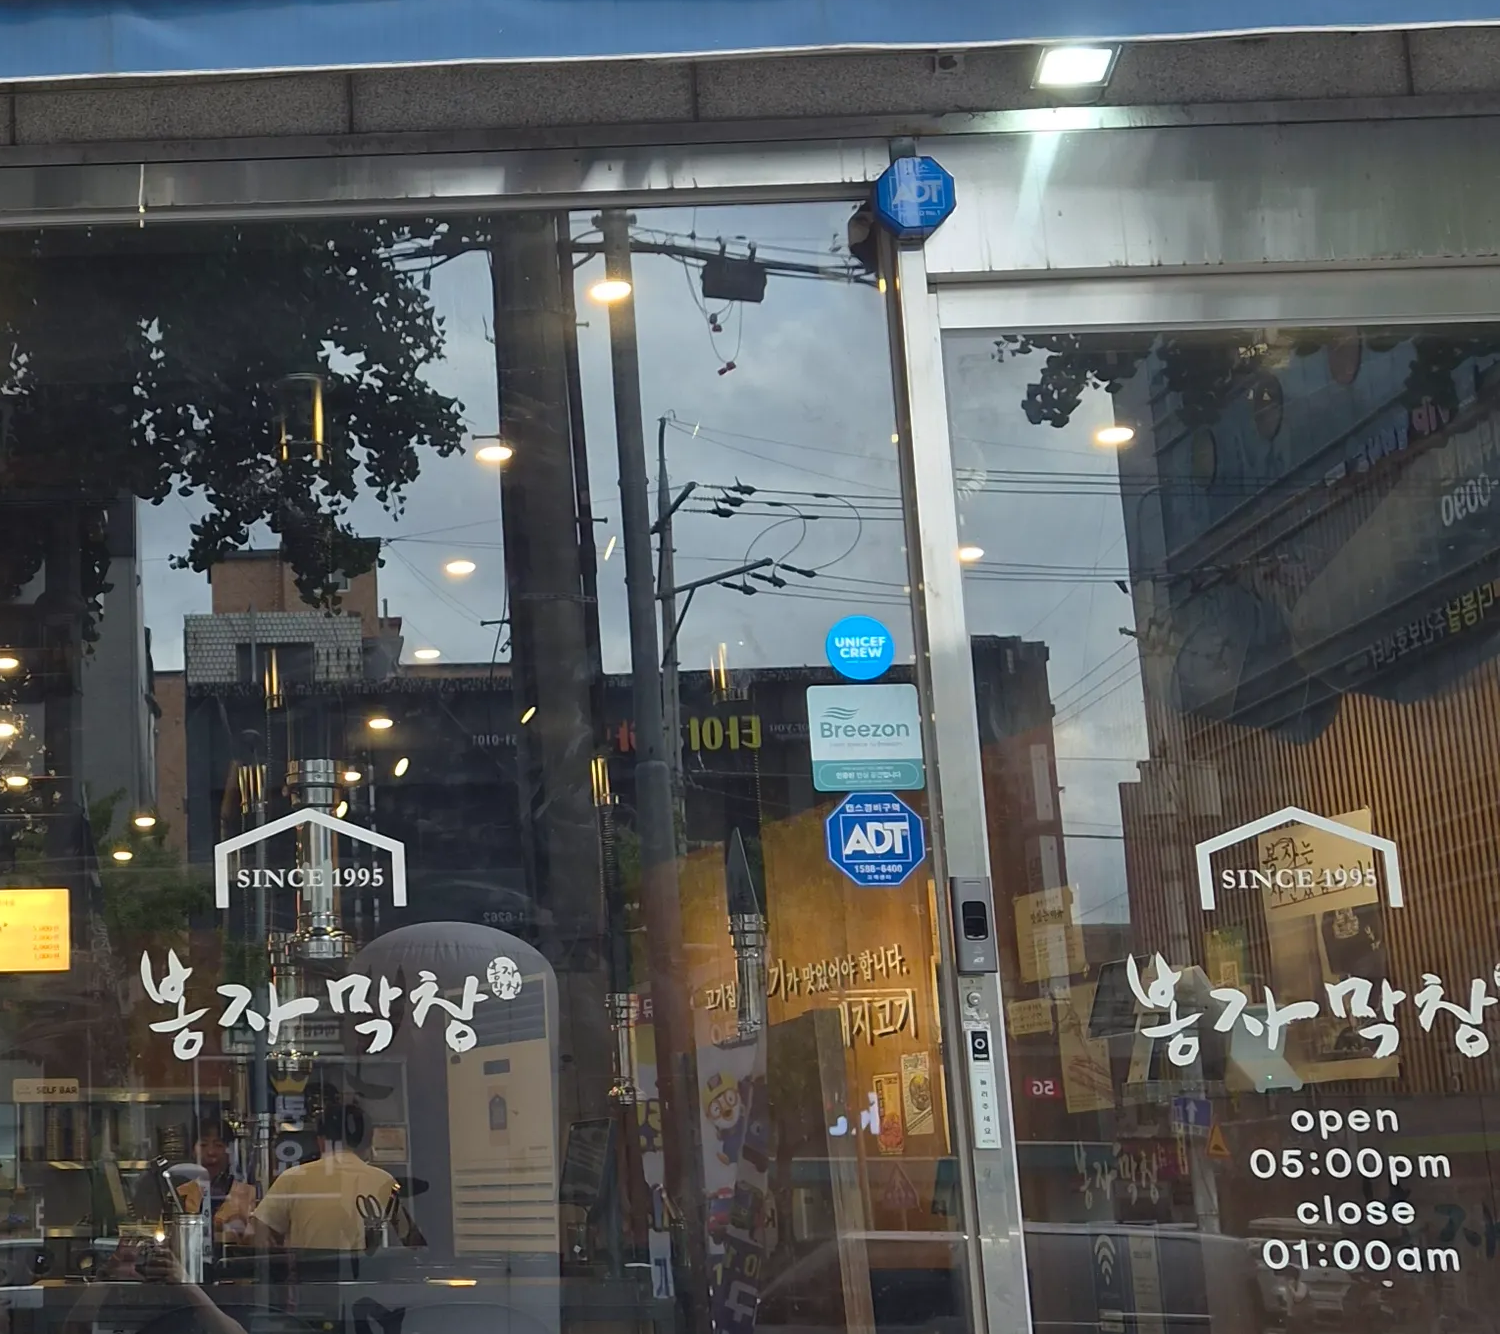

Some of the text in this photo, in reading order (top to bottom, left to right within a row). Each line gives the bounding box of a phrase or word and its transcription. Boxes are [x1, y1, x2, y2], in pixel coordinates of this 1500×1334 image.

[834, 636, 886, 648] UNICEF
[839, 647, 883, 658] CREW
[820, 722, 910, 739] Breezon
[844, 821, 908, 855] ADT
[237, 867, 384, 889] SINCE 1995
[1222, 869, 1315, 889] SINCE
[1322, 868, 1377, 888] 1995
[802, 944, 910, 995] 맛있어야 합니다.
[140, 948, 489, 1061] 봉자막창
[1126, 951, 1498, 1067] 봉자막창
[36, 1086, 78, 1095] SELF BAR
[1290, 1107, 1400, 1139] open
[1249, 1148, 1451, 1185] 05:00pm
[1297, 1194, 1416, 1226] close
[1262, 1239, 1461, 1273] 01:00am
